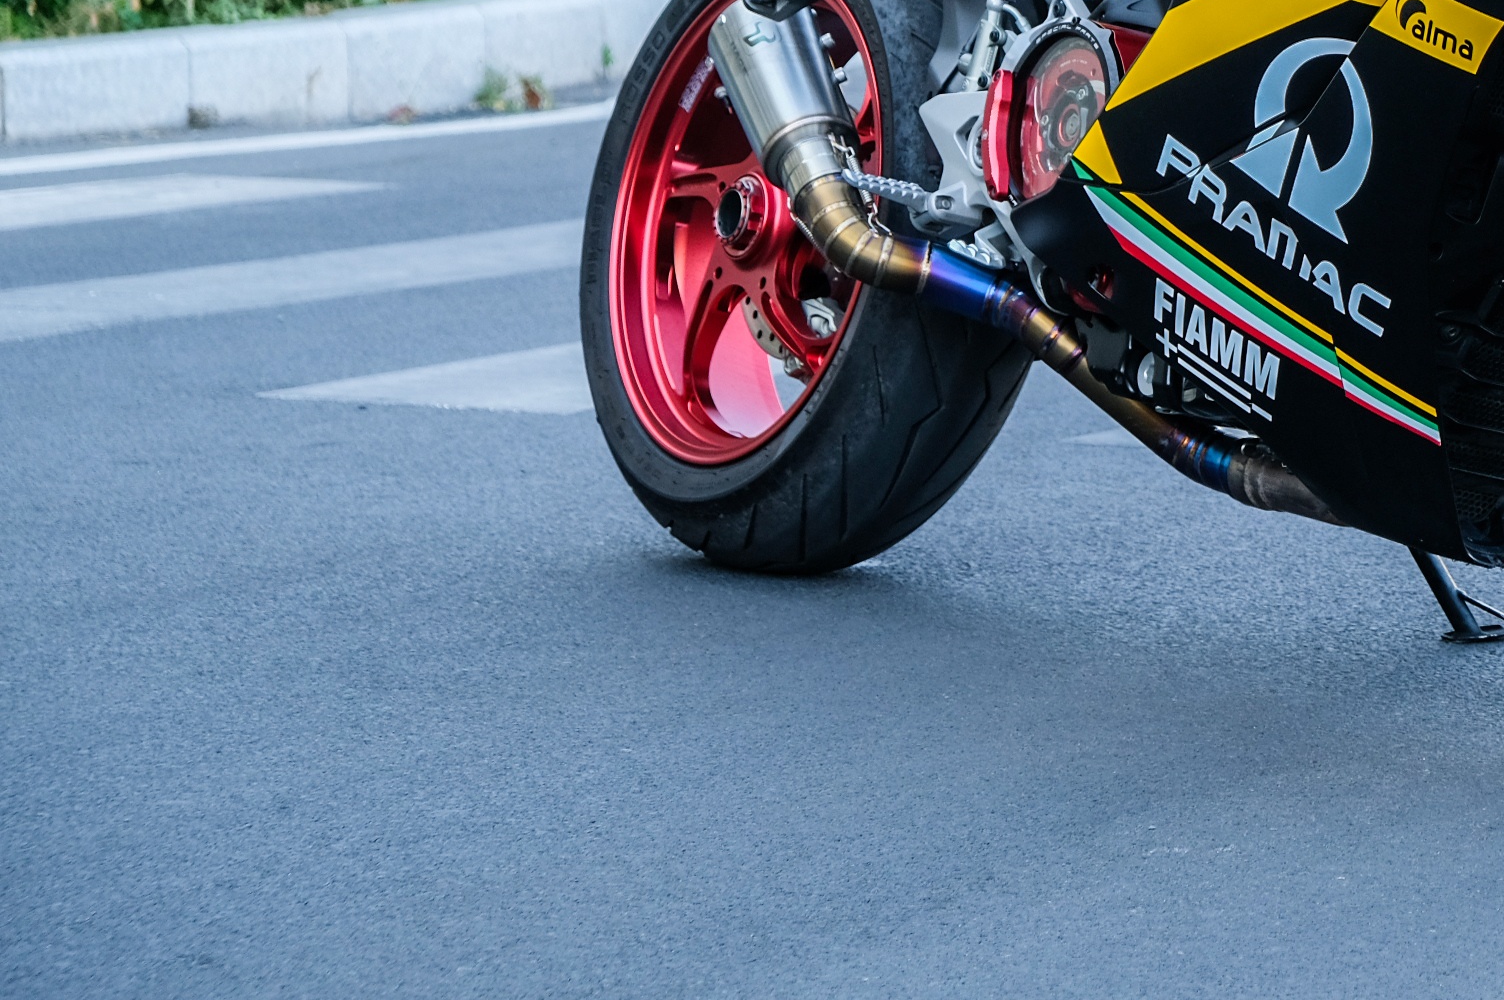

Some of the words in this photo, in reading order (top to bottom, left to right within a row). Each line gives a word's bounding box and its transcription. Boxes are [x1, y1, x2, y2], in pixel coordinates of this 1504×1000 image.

[1412, 18, 1474, 61] alma
[1155, 133, 1392, 338] PRAMAC
[1154, 277, 1281, 401] FIAMM
